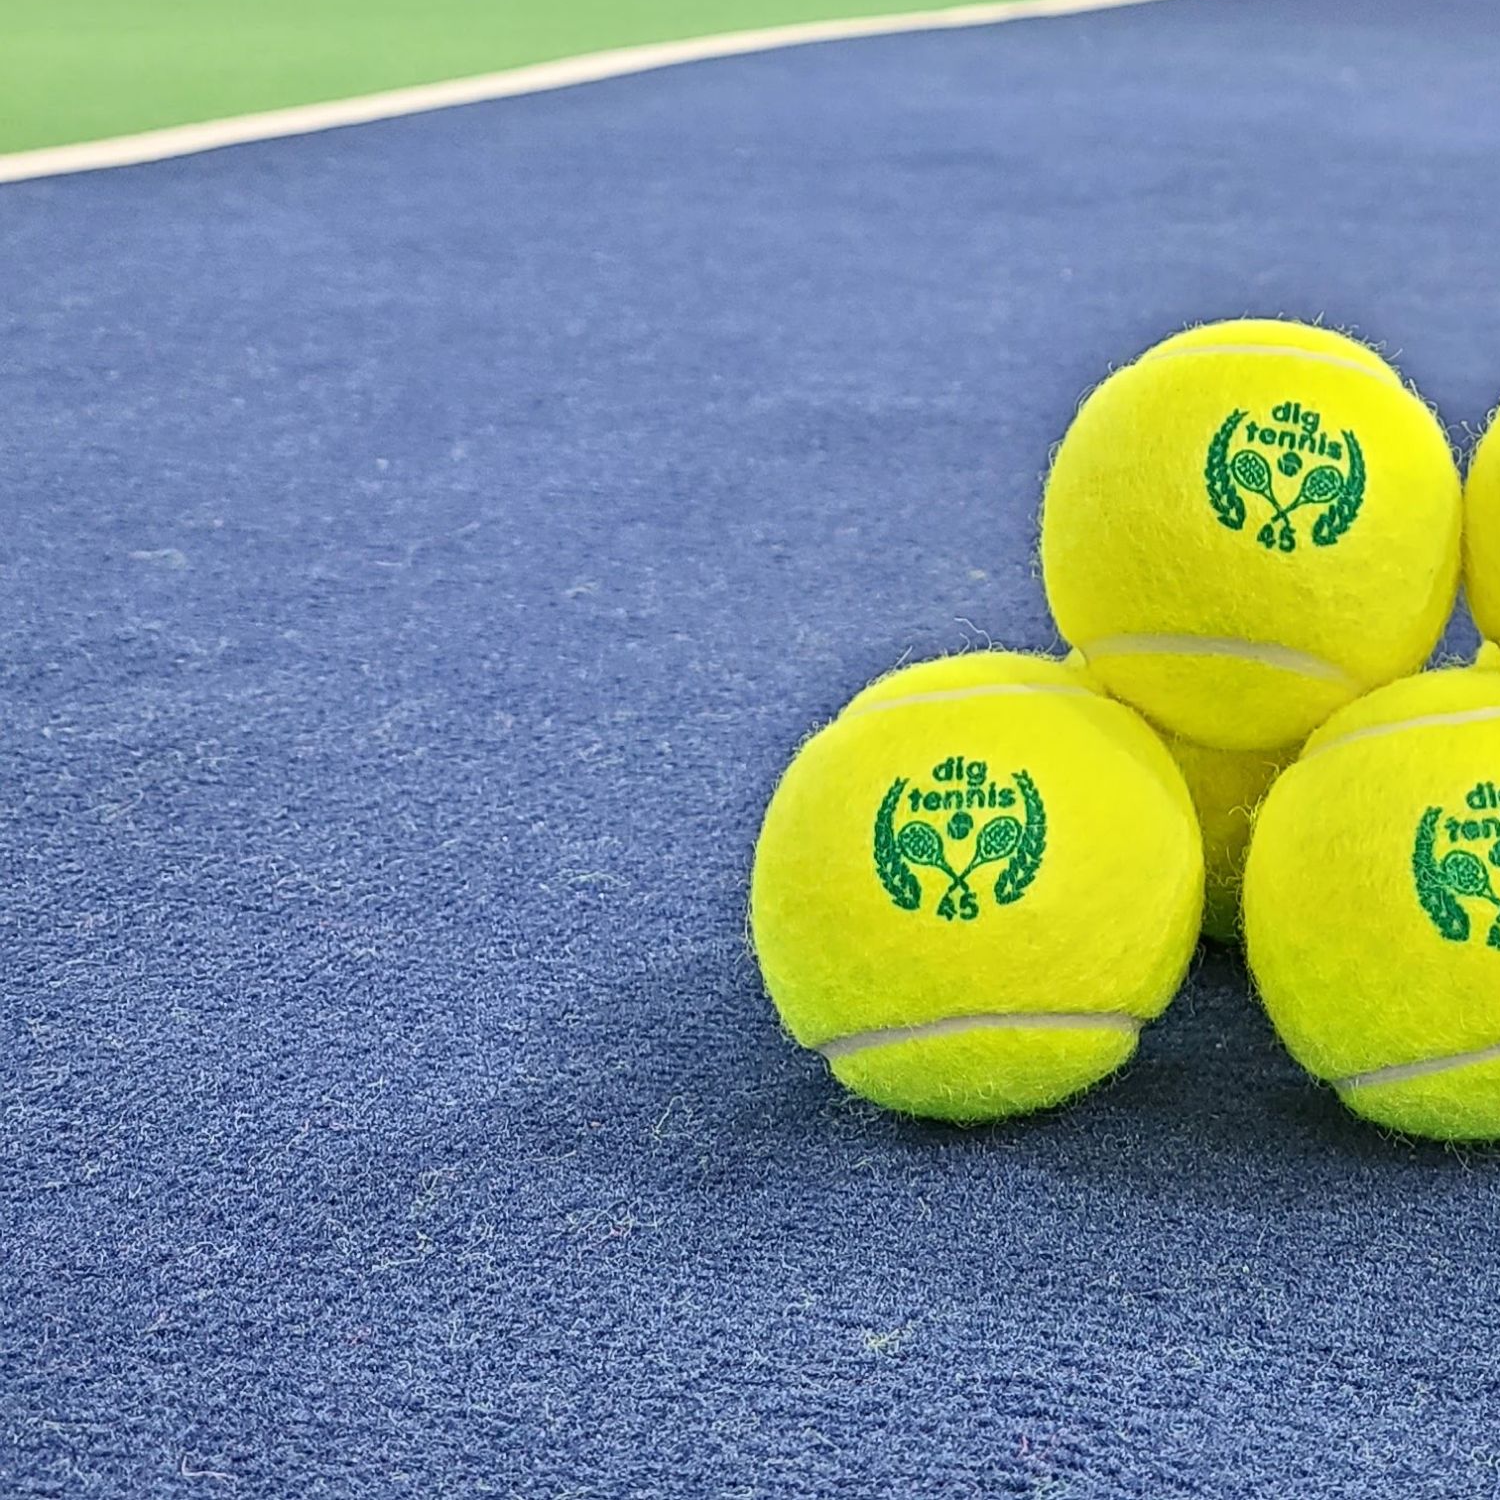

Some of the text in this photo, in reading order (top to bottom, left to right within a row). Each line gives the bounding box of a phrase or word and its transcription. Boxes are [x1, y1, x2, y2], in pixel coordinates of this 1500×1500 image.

[1272, 401, 1320, 434] dig
[1245, 421, 1342, 460] tennis
[1257, 524, 1296, 552] 45
[932, 756, 987, 786] dig
[908, 781, 1016, 812] tennis
[936, 892, 979, 921] 45
